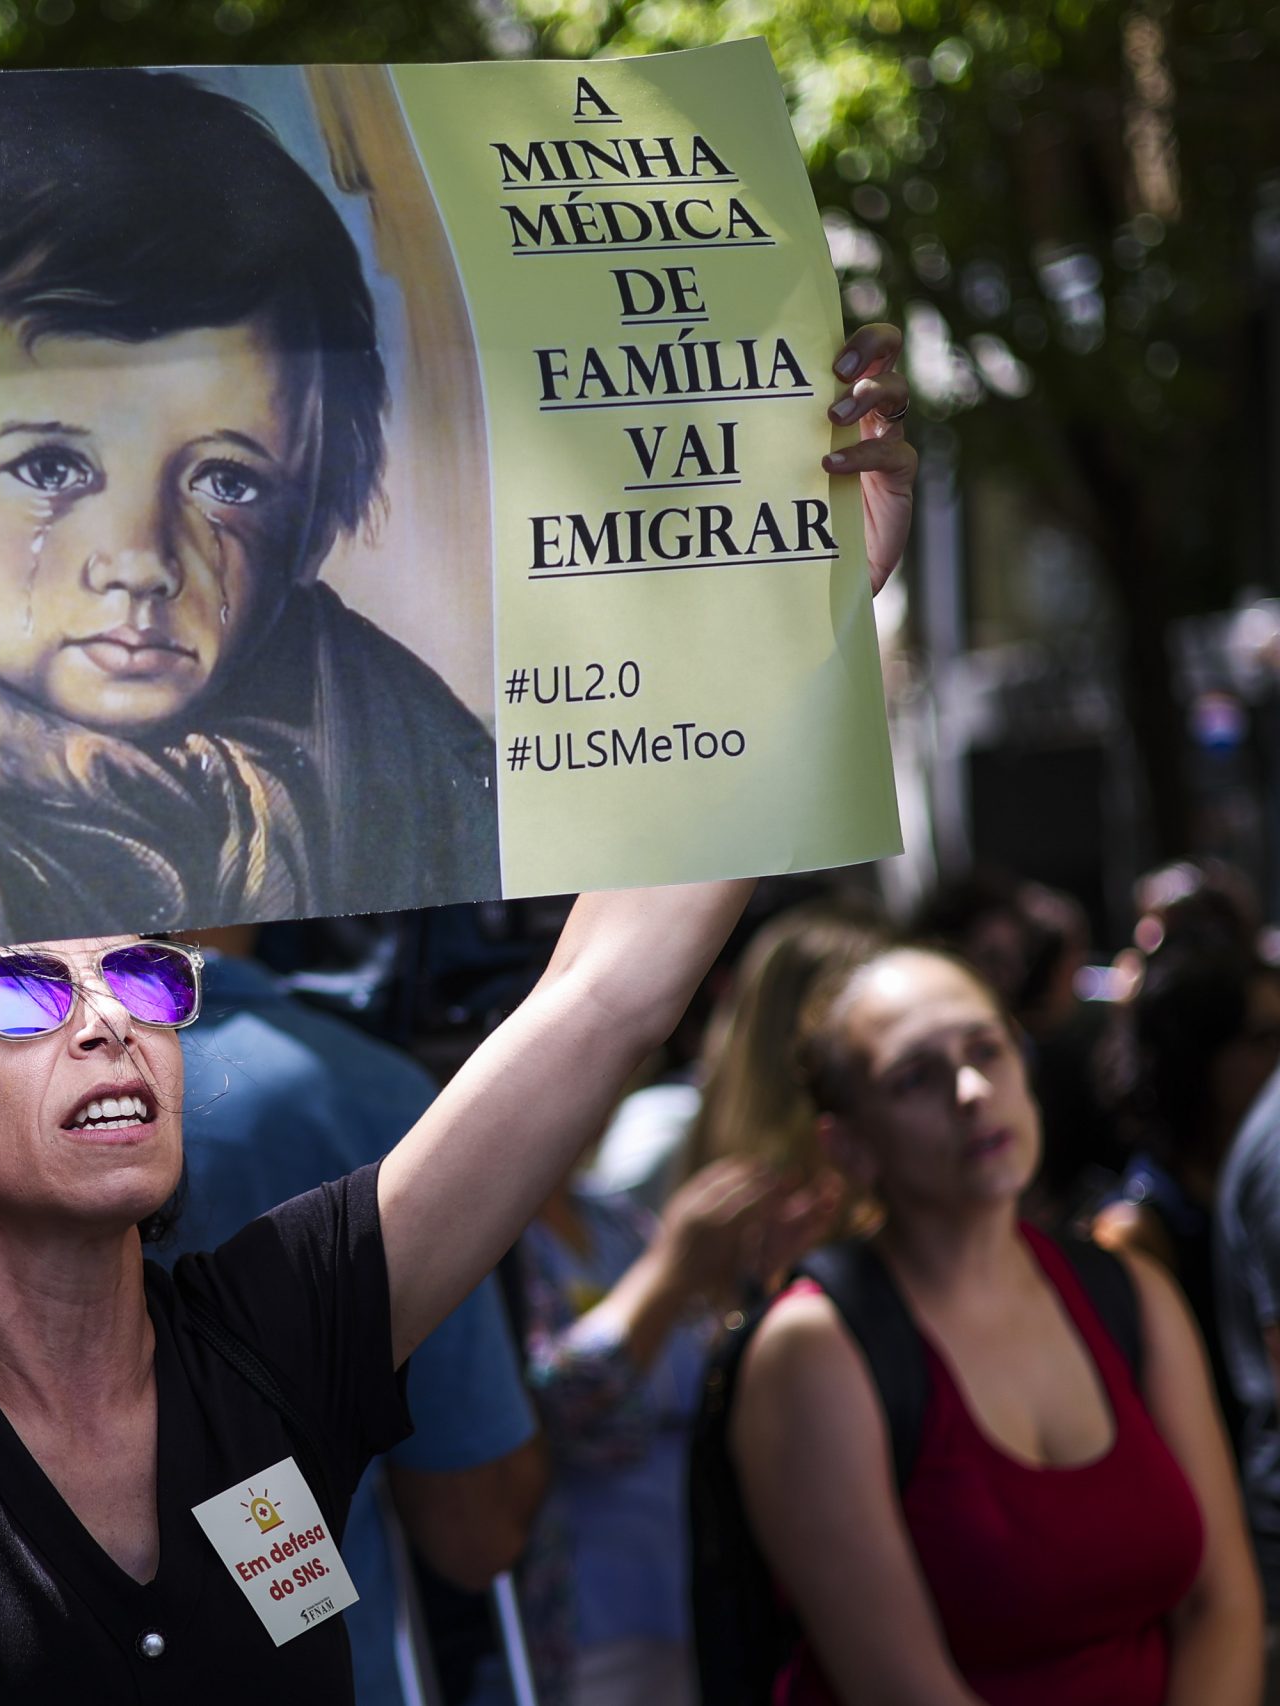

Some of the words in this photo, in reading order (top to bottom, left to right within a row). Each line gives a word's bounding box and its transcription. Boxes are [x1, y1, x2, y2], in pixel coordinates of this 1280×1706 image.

[573, 76, 619, 117] A
[490, 135, 736, 184] MINHA
[500, 191, 772, 248] MÉDICA
[609, 267, 706, 317] DE
[533, 328, 812, 401] FAMÍLIA
[623, 422, 740, 479] VAI
[528, 499, 839, 569] EMIGRAR
[505, 661, 640, 704] #UL2.0
[507, 723, 746, 772] #ULSMeToo
[235, 1556, 271, 1582] Em
[269, 1524, 326, 1563] defesa
[269, 1579, 295, 1601] do
[292, 1558, 330, 1587] SNS.
